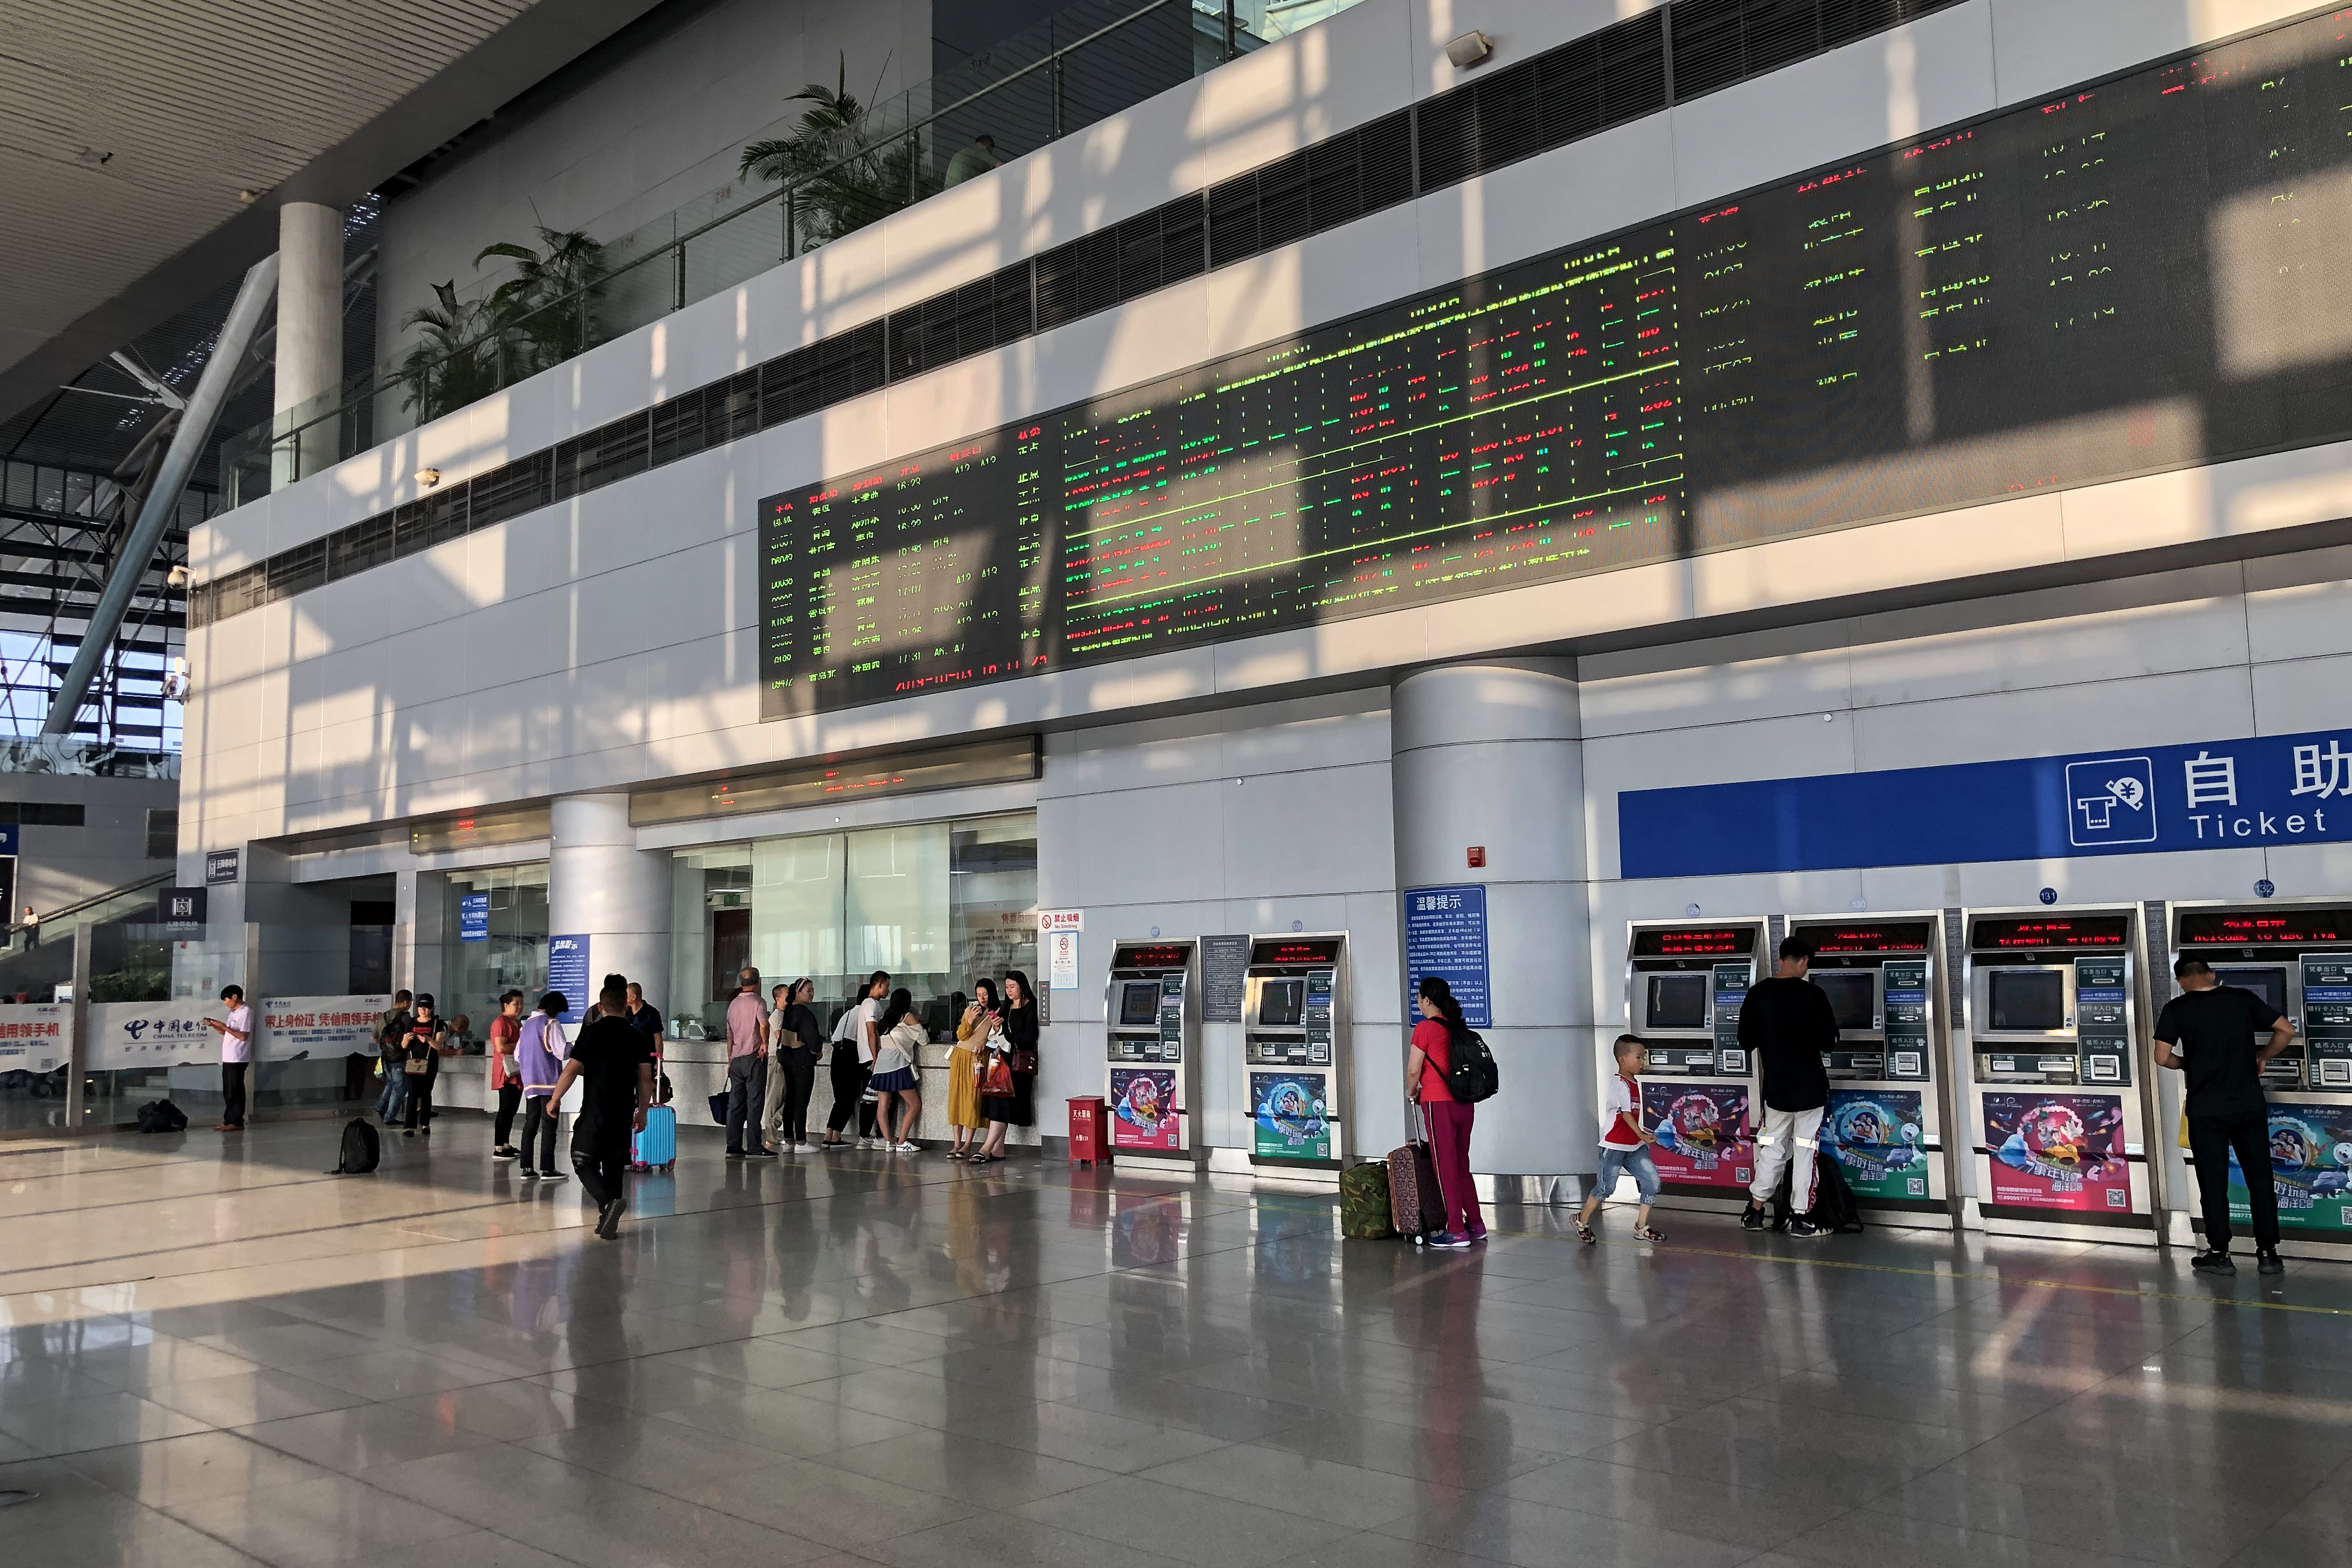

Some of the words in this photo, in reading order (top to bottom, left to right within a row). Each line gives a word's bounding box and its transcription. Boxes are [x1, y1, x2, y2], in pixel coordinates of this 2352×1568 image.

[2189, 808, 2327, 839] Ticket
[2255, 884, 2274, 894] 132
[1416, 894, 1462, 911] 温馨提示
[2041, 892, 2056, 901] 131
[1686, 907, 1700, 915] 129
[1054, 913, 1079, 922] 禁止吸烟
[153, 1019, 208, 1034] 中国电信
[264, 1013, 316, 1028] 带上身份证
